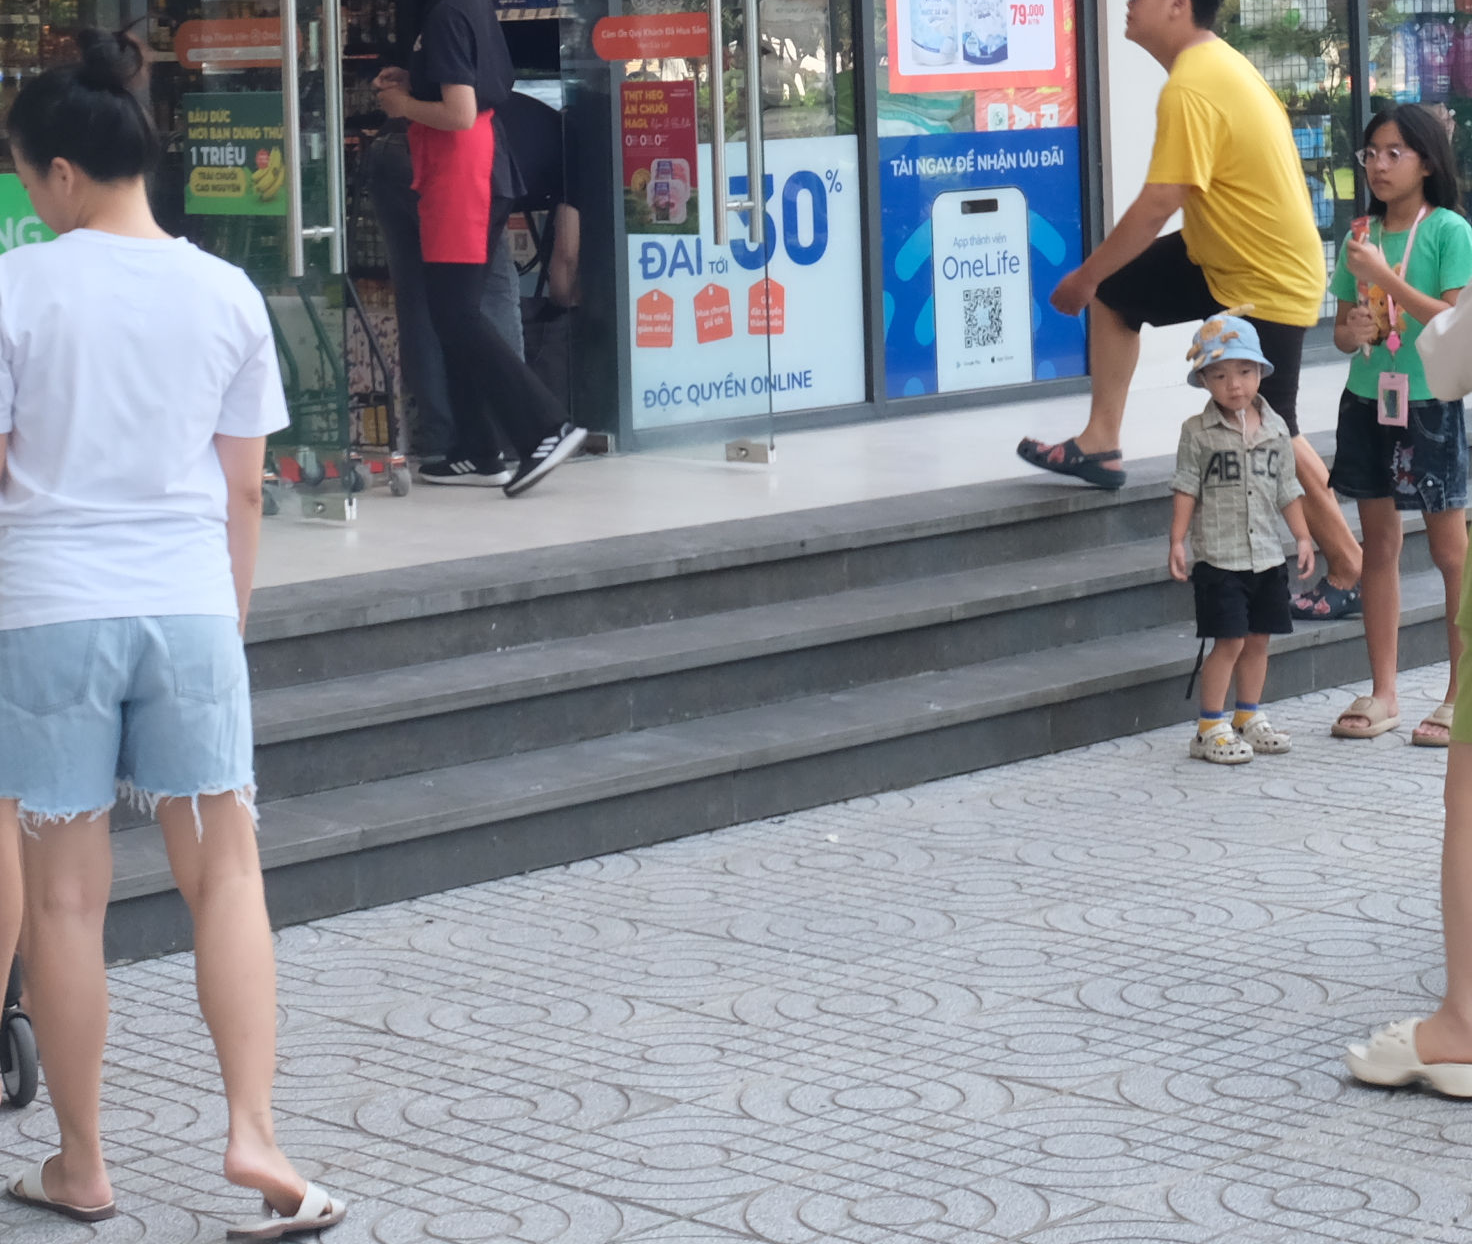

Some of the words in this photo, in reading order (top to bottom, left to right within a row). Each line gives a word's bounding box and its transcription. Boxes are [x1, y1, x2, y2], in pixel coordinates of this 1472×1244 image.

[645, 90, 664, 100] HEO
[190, 147, 197, 165] 1
[200, 143, 246, 169] TRIỆU
[890, 154, 913, 176] TẢI
[916, 157, 953, 175] NGAY
[955, 148, 975, 173] ĐỂ
[977, 149, 1017, 174] NHẬN
[1019, 149, 1038, 167] ƯU
[1041, 146, 1064, 166] ĐÃI
[953, 237, 968, 249] App
[970, 234, 991, 246] thành
[992, 234, 1007, 244] viên
[709, 257, 729, 274] TỚI
[943, 250, 1020, 280] OneLife
[643, 382, 683, 411] ĐỘC
[687, 372, 746, 406] QUYỀN
[751, 370, 813, 394] ONLINE
